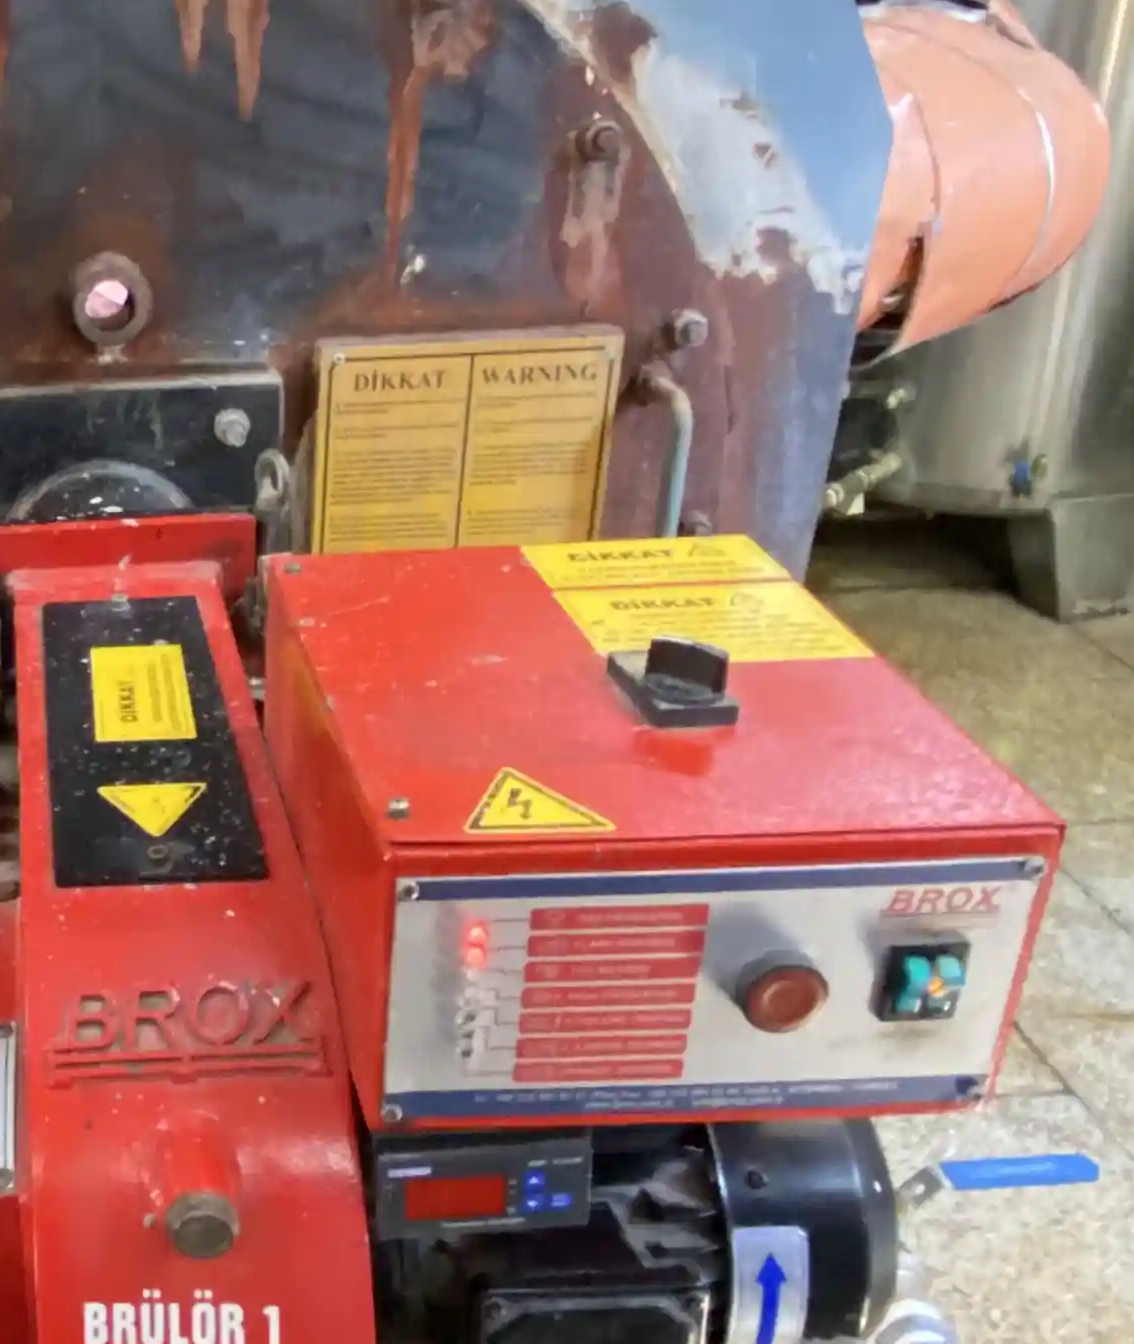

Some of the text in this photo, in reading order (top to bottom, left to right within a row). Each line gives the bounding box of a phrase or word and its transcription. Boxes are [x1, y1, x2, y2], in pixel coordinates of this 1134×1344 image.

[354, 363, 599, 393] DİKKAT WARNING
[879, 885, 1003, 917] BROX
[49, 981, 324, 1055] BROX
